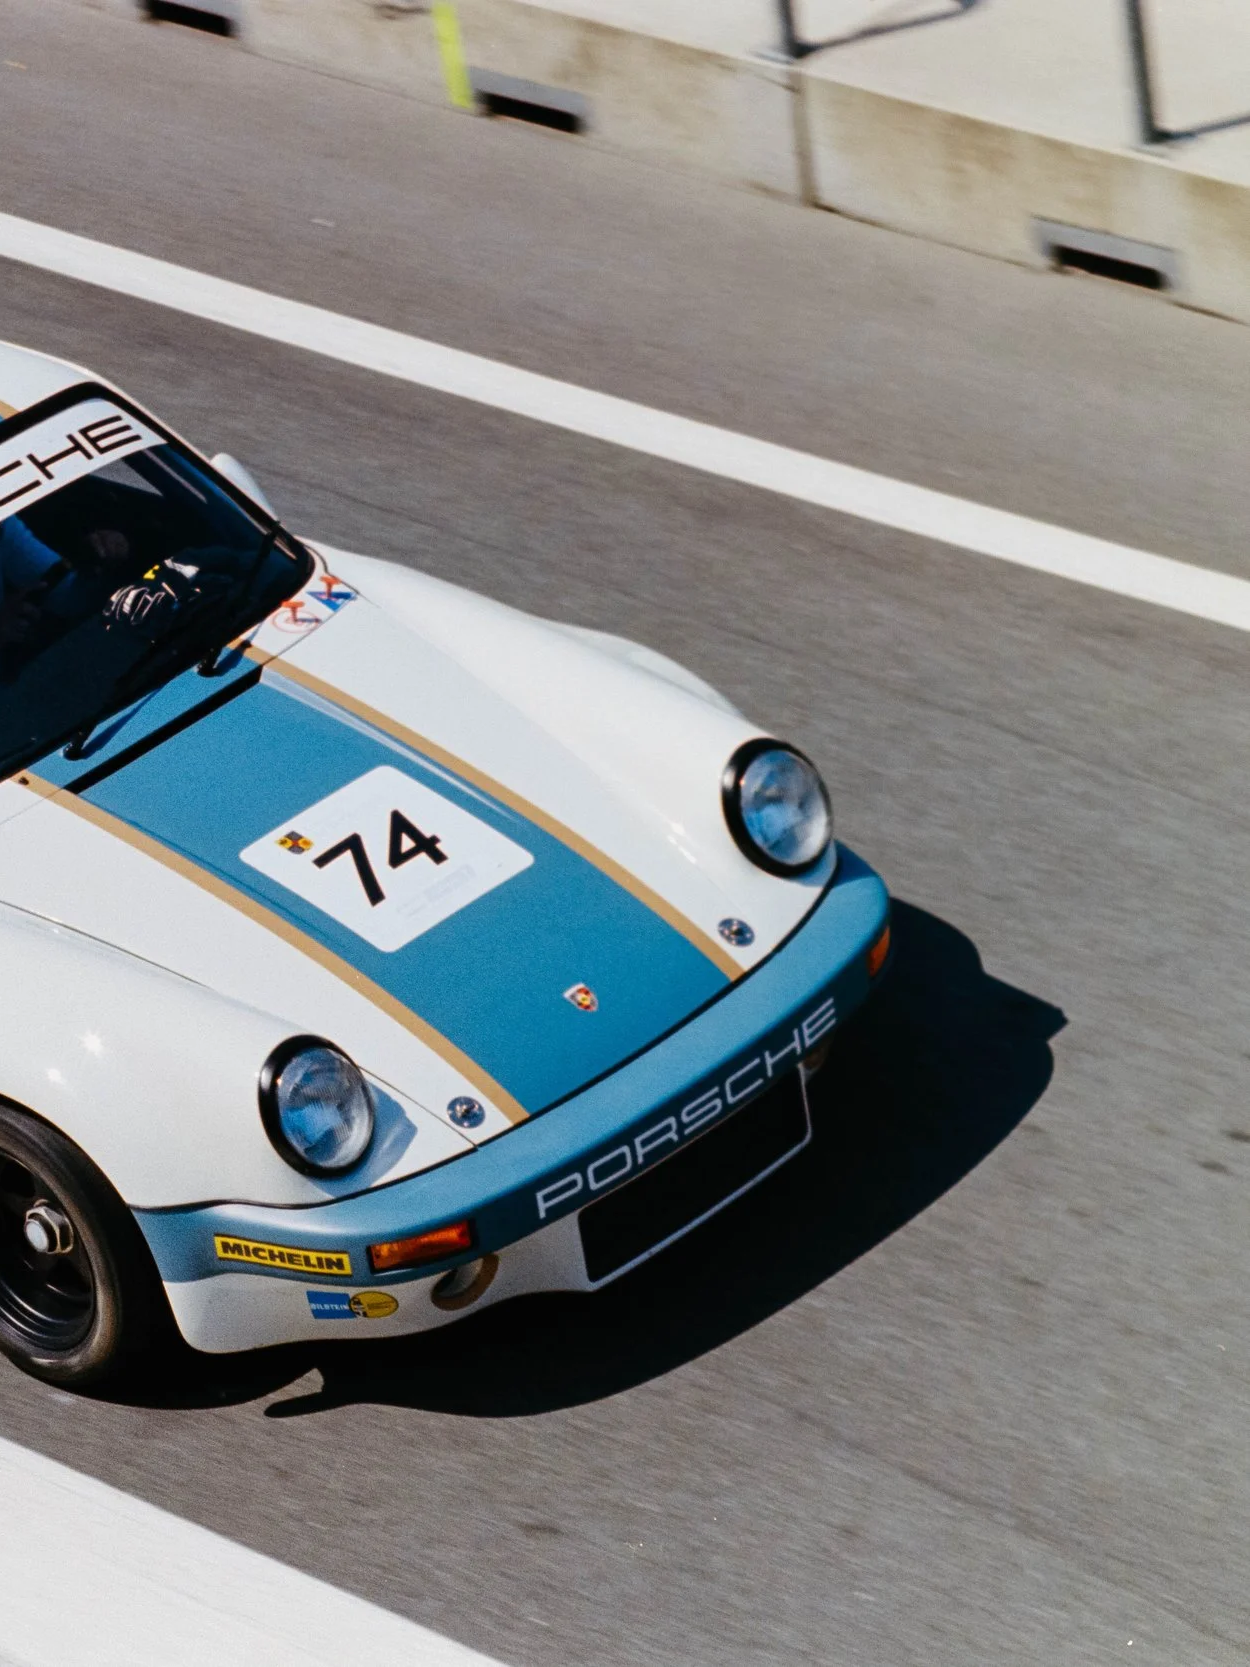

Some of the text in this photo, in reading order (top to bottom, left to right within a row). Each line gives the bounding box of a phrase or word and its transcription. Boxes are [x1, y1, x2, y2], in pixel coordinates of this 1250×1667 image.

[312, 809, 449, 907] 74
[535, 998, 837, 1220] PORSCHE
[220, 1241, 346, 1271] MICHELIN
[310, 1302, 351, 1312] BILSTEIN
